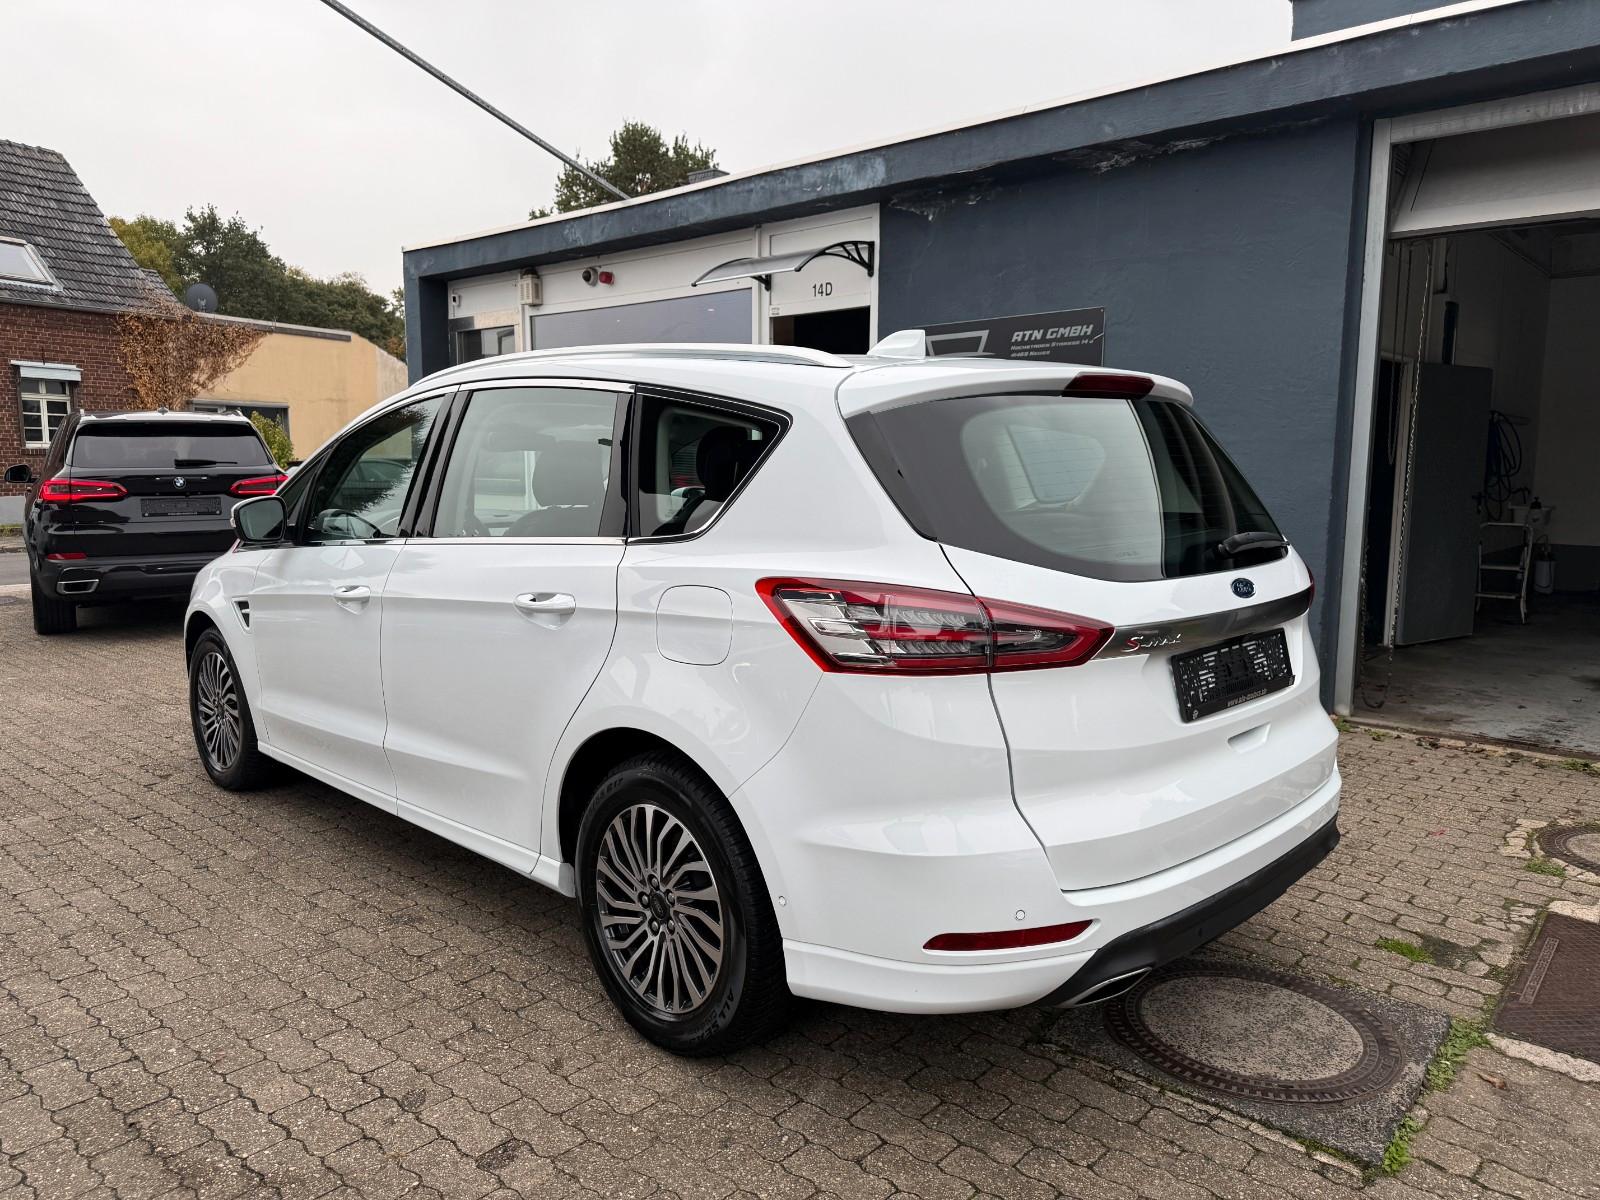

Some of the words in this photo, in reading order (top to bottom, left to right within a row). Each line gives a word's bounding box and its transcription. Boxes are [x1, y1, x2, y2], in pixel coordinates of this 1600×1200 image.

[812, 281, 833, 298] 14D
[1011, 329, 1044, 342] ATN
[1046, 324, 1094, 339] GMBH
